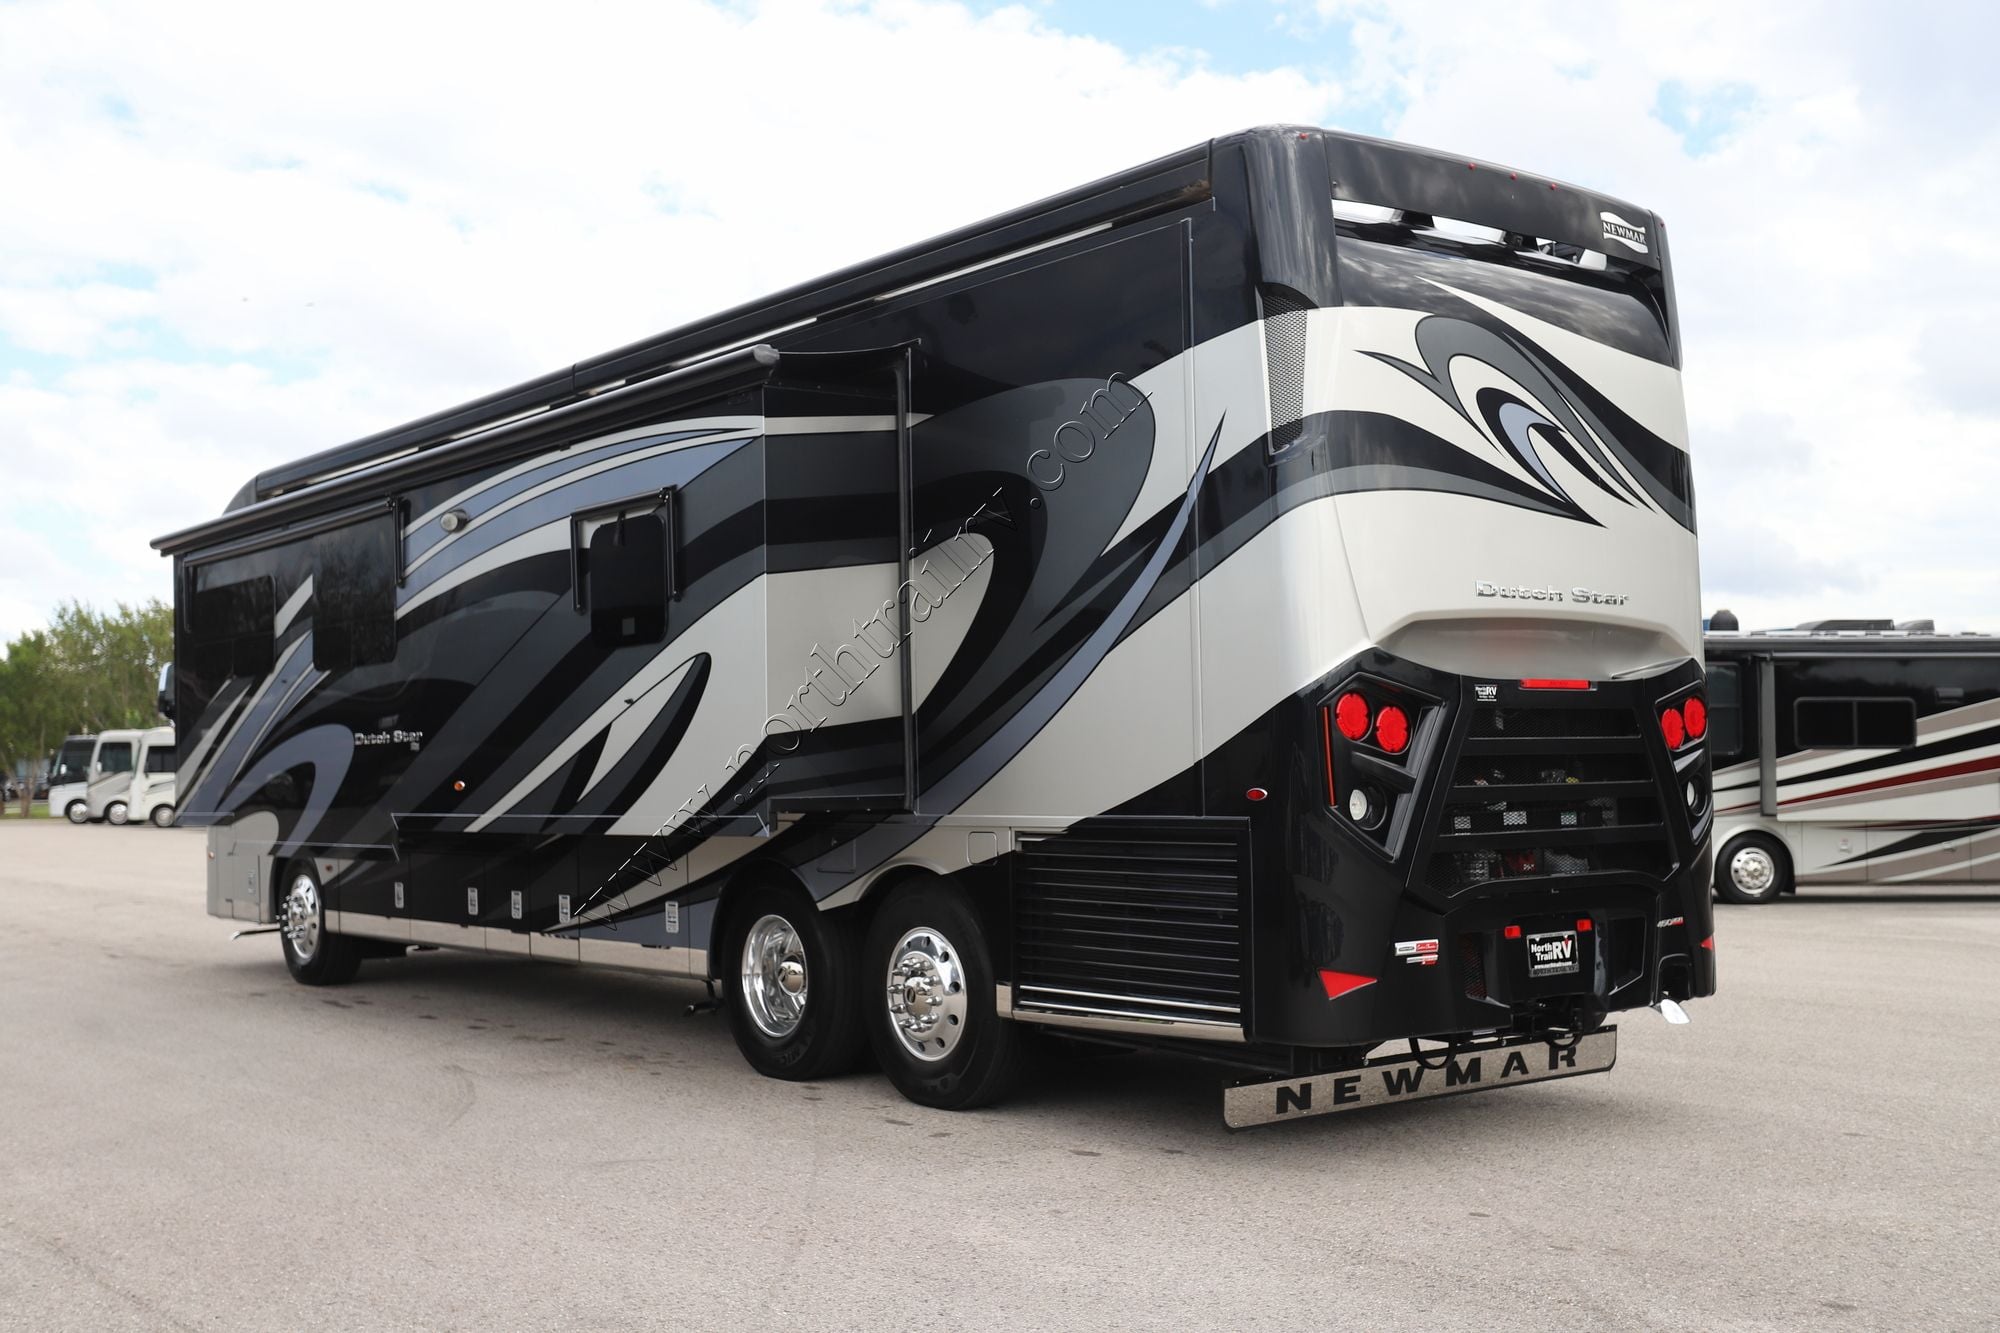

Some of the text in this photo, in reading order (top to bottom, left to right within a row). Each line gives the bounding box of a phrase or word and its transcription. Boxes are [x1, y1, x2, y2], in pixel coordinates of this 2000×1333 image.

[1603, 221, 1647, 245] NEWMAR
[1475, 579, 1630, 606] Dutch Star
[354, 729, 423, 746] Dutch Star
[1531, 940, 1573, 960] North RV
[1535, 951, 1553, 961] Trail
[1275, 1044, 1577, 1114] NEWMAR
